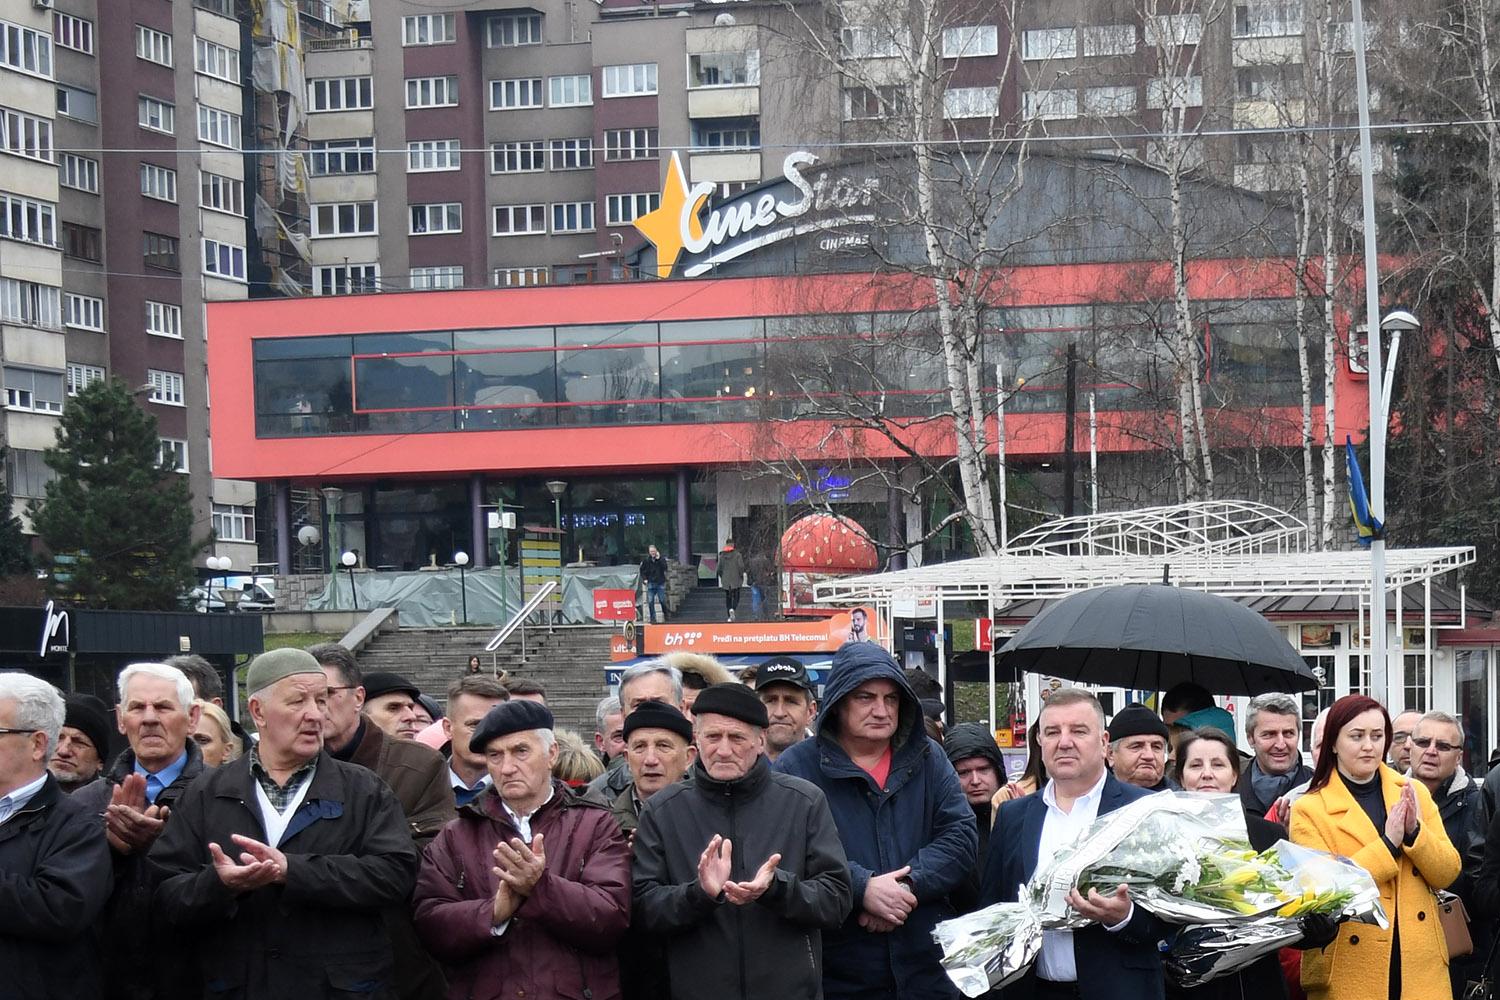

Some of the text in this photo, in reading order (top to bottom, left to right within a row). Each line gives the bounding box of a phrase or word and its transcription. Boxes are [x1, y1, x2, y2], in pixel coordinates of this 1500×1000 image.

[819, 234, 870, 250] CINEMAS
[743, 634, 778, 644] pretplatu
[779, 633, 790, 642] BH
[613, 643, 637, 653] ulta
